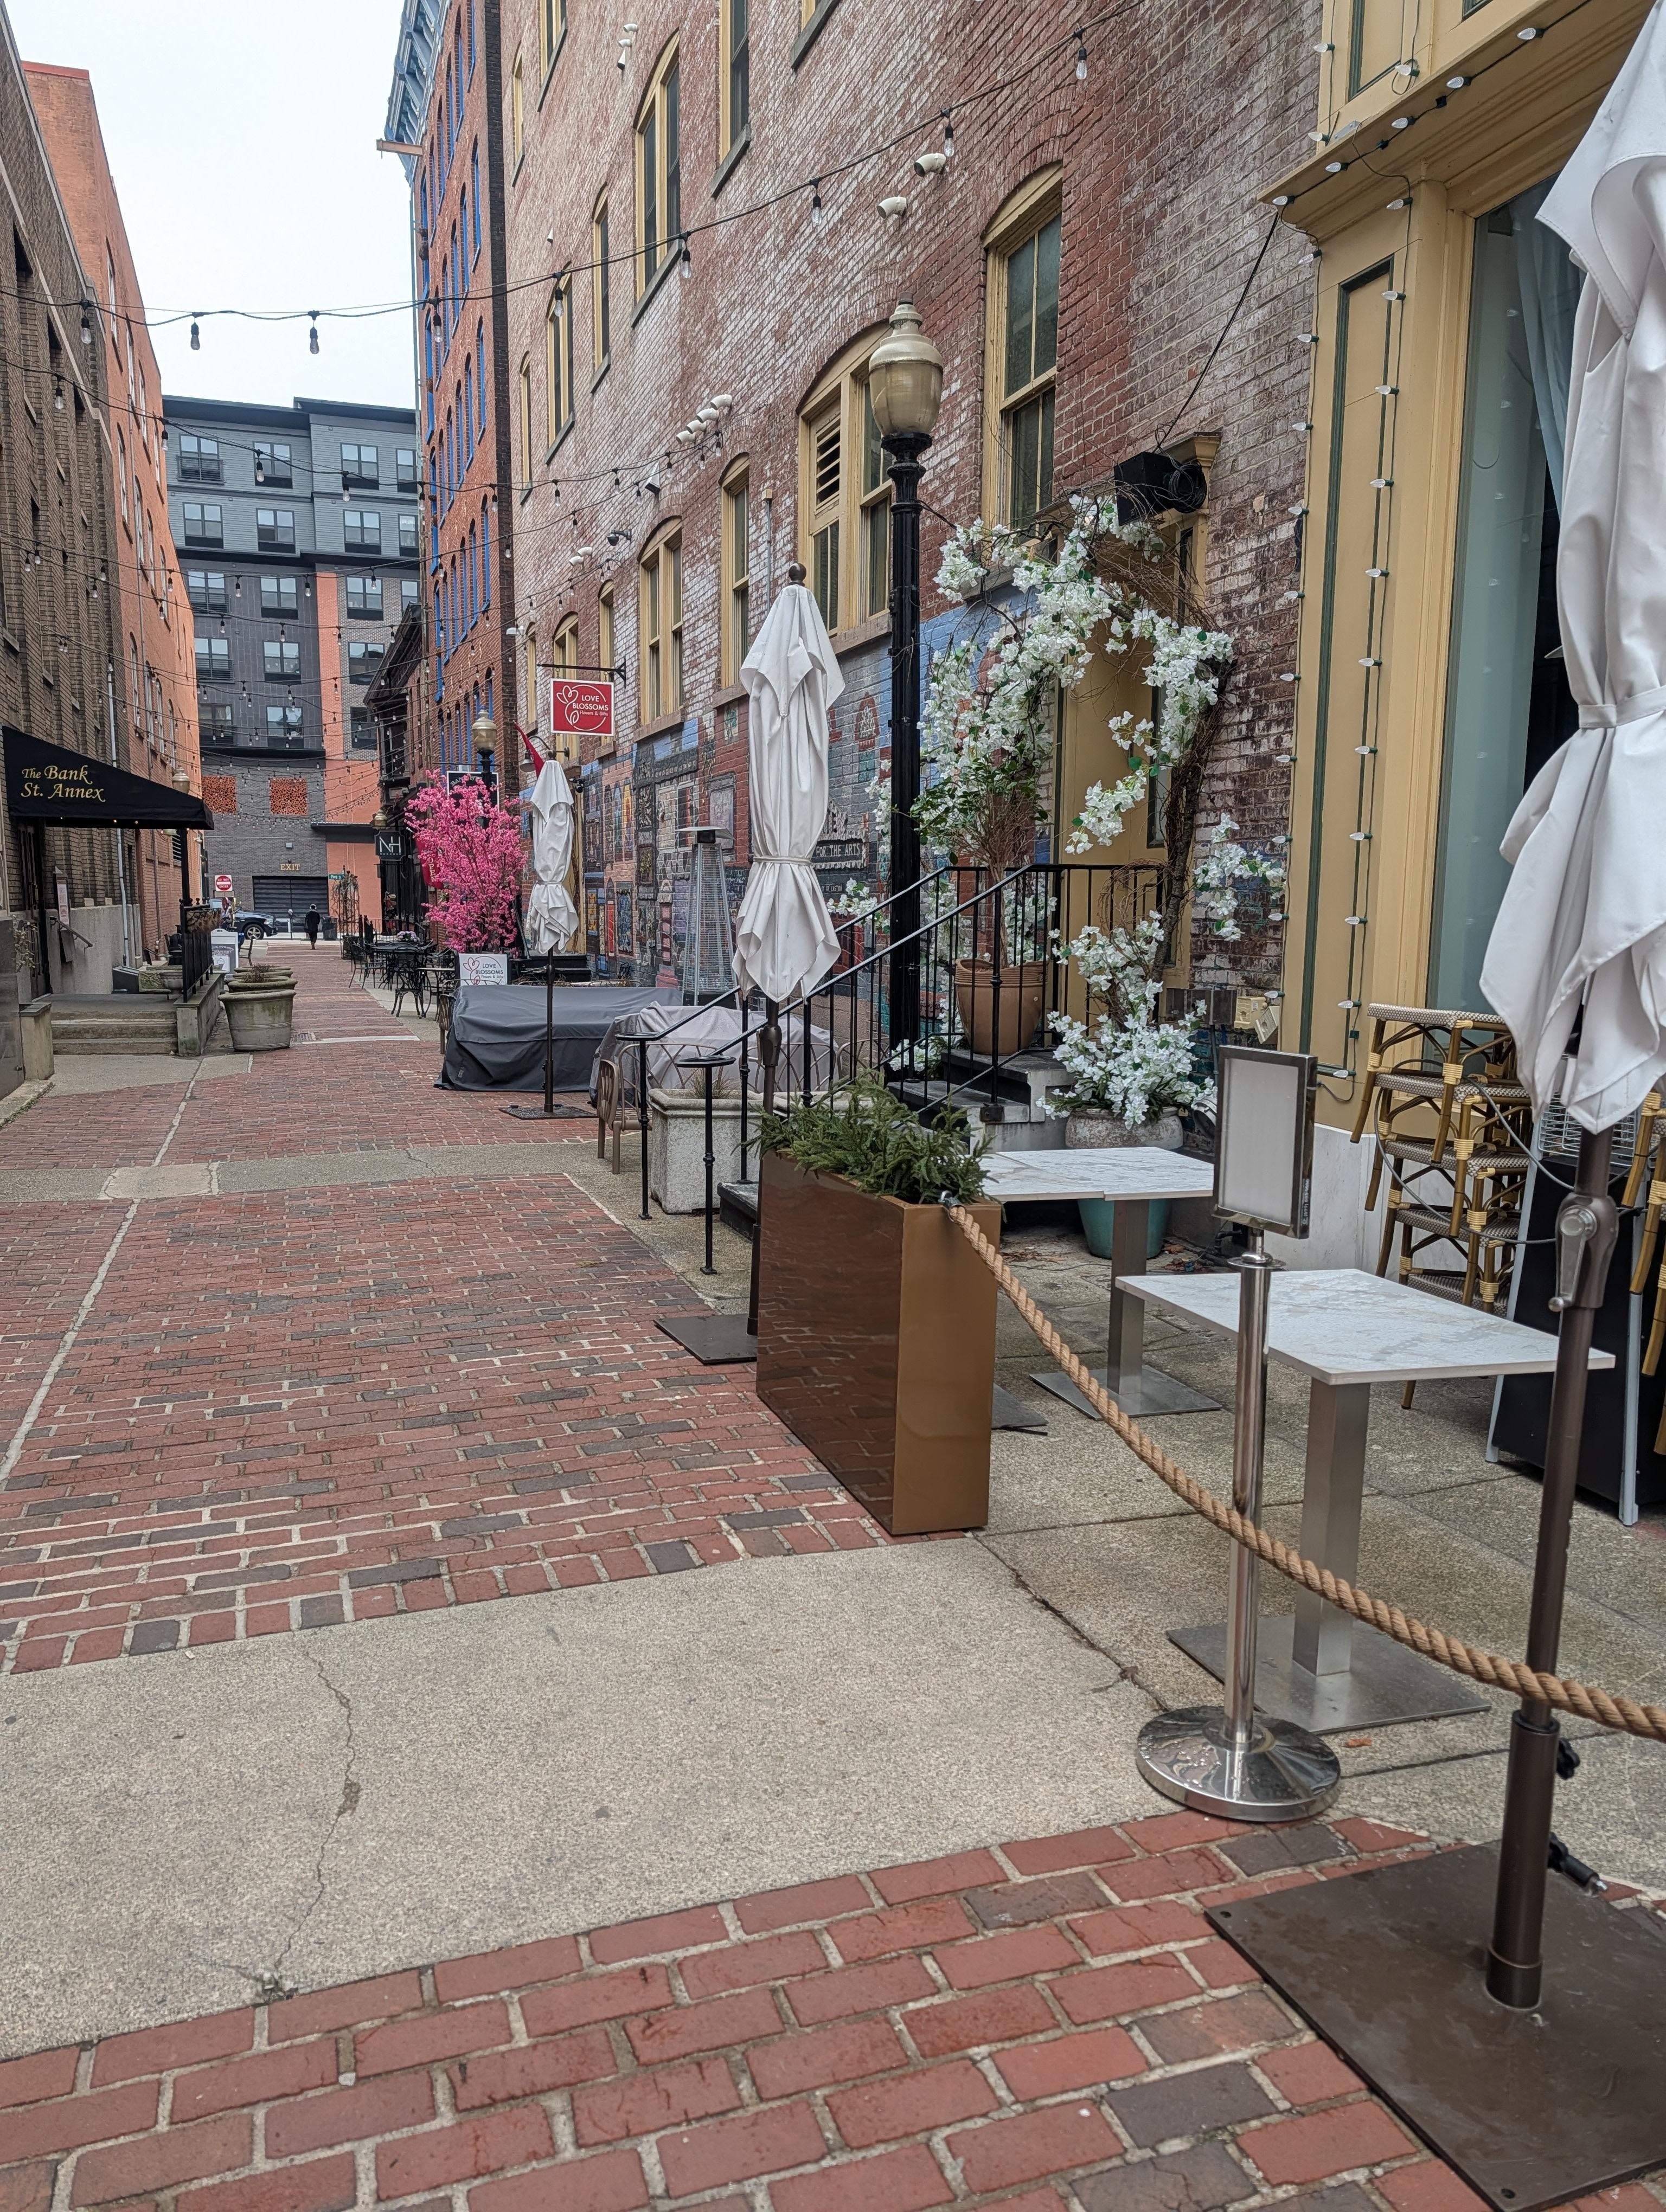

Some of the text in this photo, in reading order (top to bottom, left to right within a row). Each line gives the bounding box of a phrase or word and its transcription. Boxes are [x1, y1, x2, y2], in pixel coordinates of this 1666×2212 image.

[572, 703, 608, 711] BLOSSOMS
[22, 764, 93, 785] The Bank
[21, 782, 106, 802] St. Annex
[380, 836, 401, 853] NH
[816, 843, 860, 857] FOR THE ARTS
